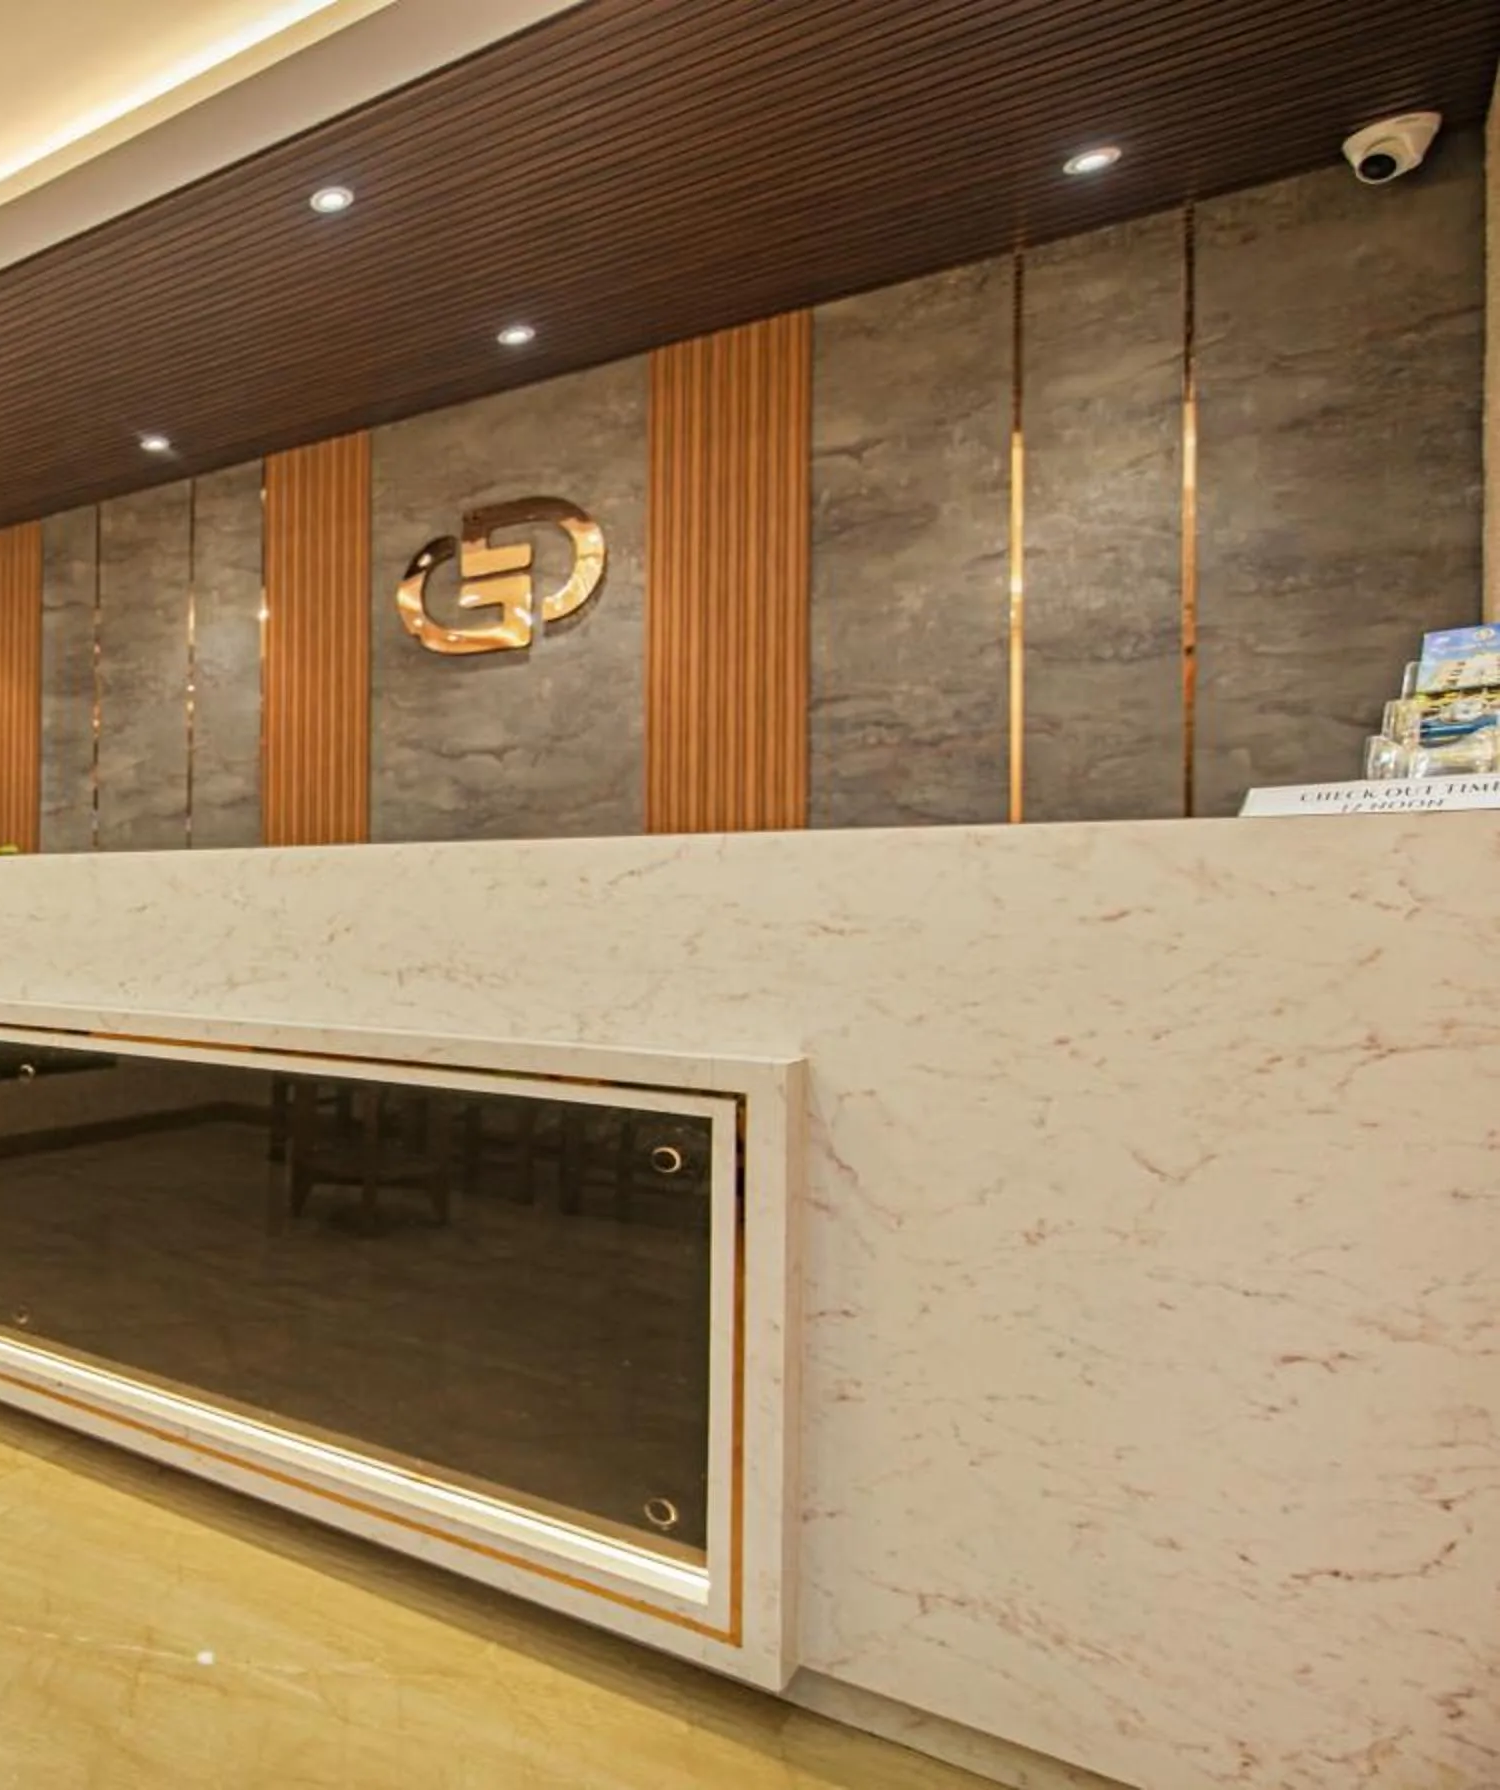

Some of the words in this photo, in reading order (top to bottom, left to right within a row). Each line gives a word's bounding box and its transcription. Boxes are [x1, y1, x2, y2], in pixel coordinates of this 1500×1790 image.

[1300, 787, 1376, 801] CHECK
[1384, 784, 1433, 797] OUT
[1370, 799, 1444, 810] NOON
